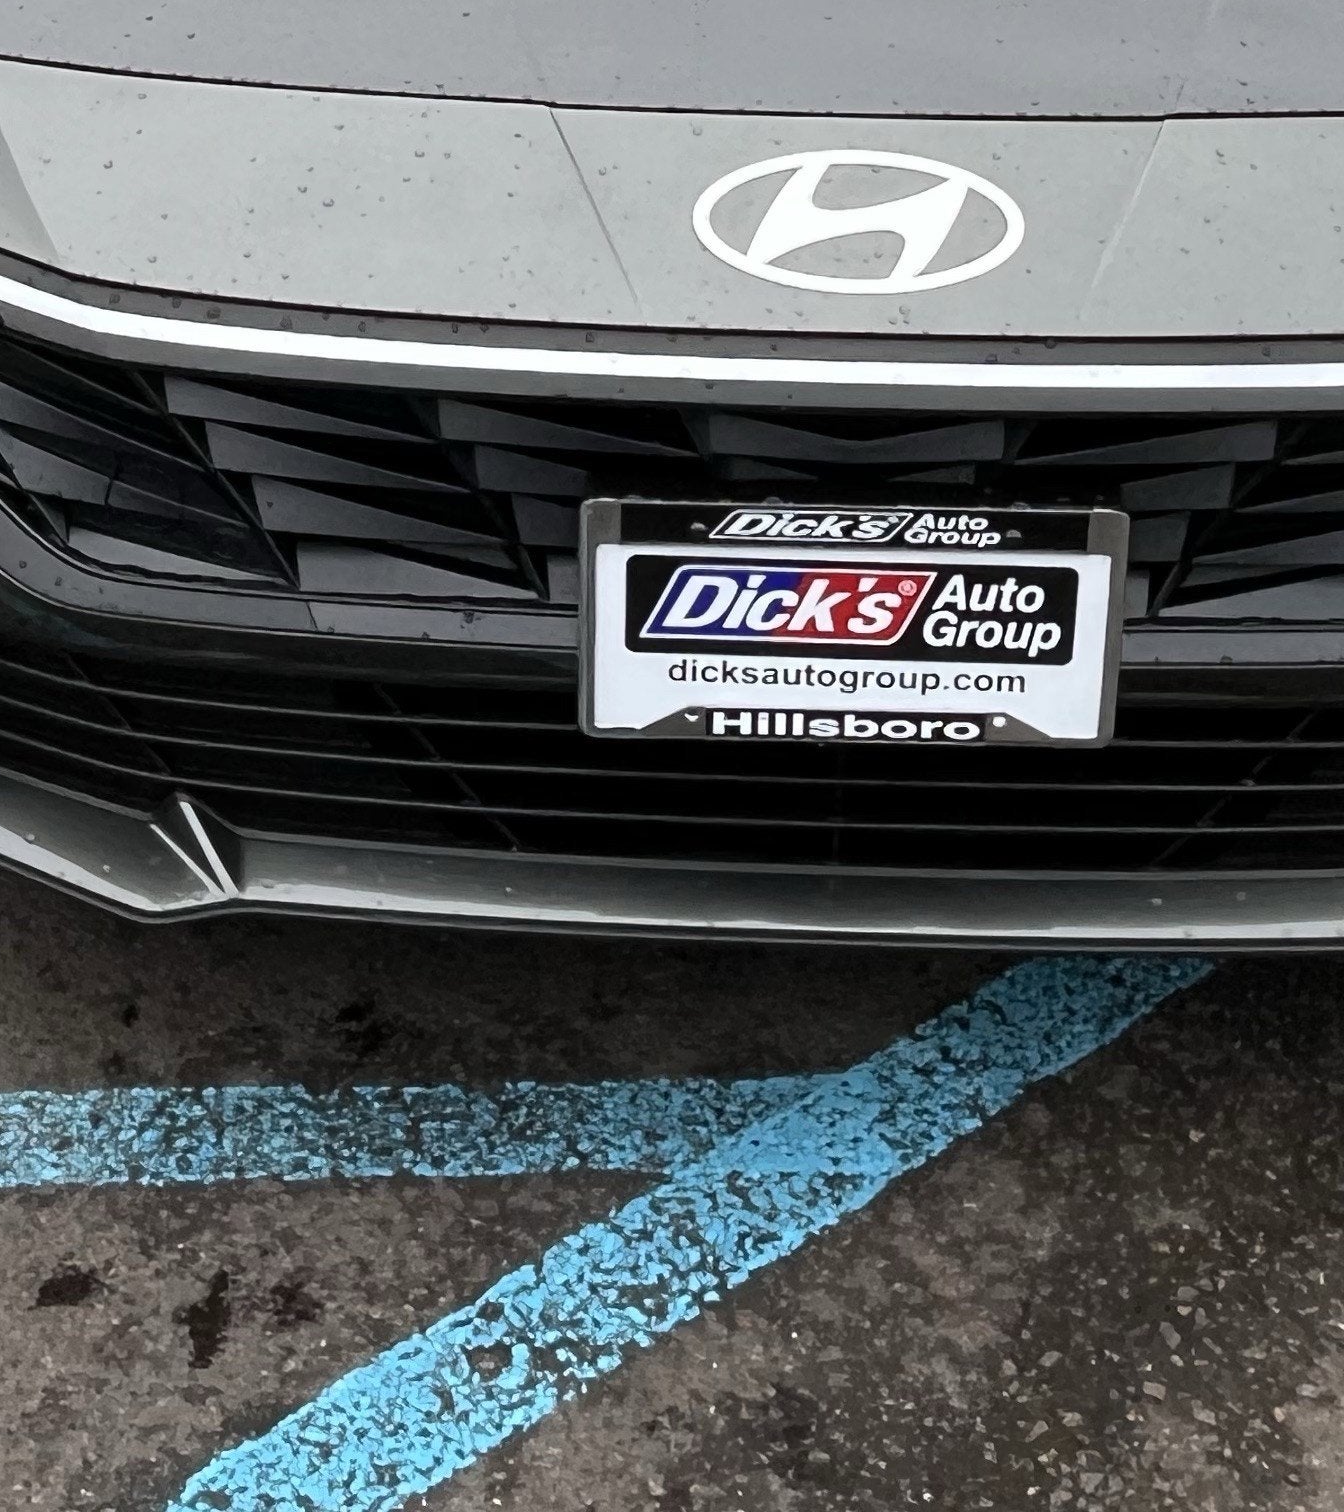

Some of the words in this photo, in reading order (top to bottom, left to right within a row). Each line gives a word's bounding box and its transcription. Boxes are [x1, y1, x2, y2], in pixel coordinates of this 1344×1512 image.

[724, 513, 889, 539] Dick's
[904, 528, 1002, 548] Group
[913, 513, 989, 531] Auto
[662, 574, 903, 635] Dick's
[932, 574, 1046, 613] Auto
[922, 610, 1062, 658] Group
[668, 659, 1027, 696] dicksautogroup.com
[712, 711, 981, 741] Hillsboro
